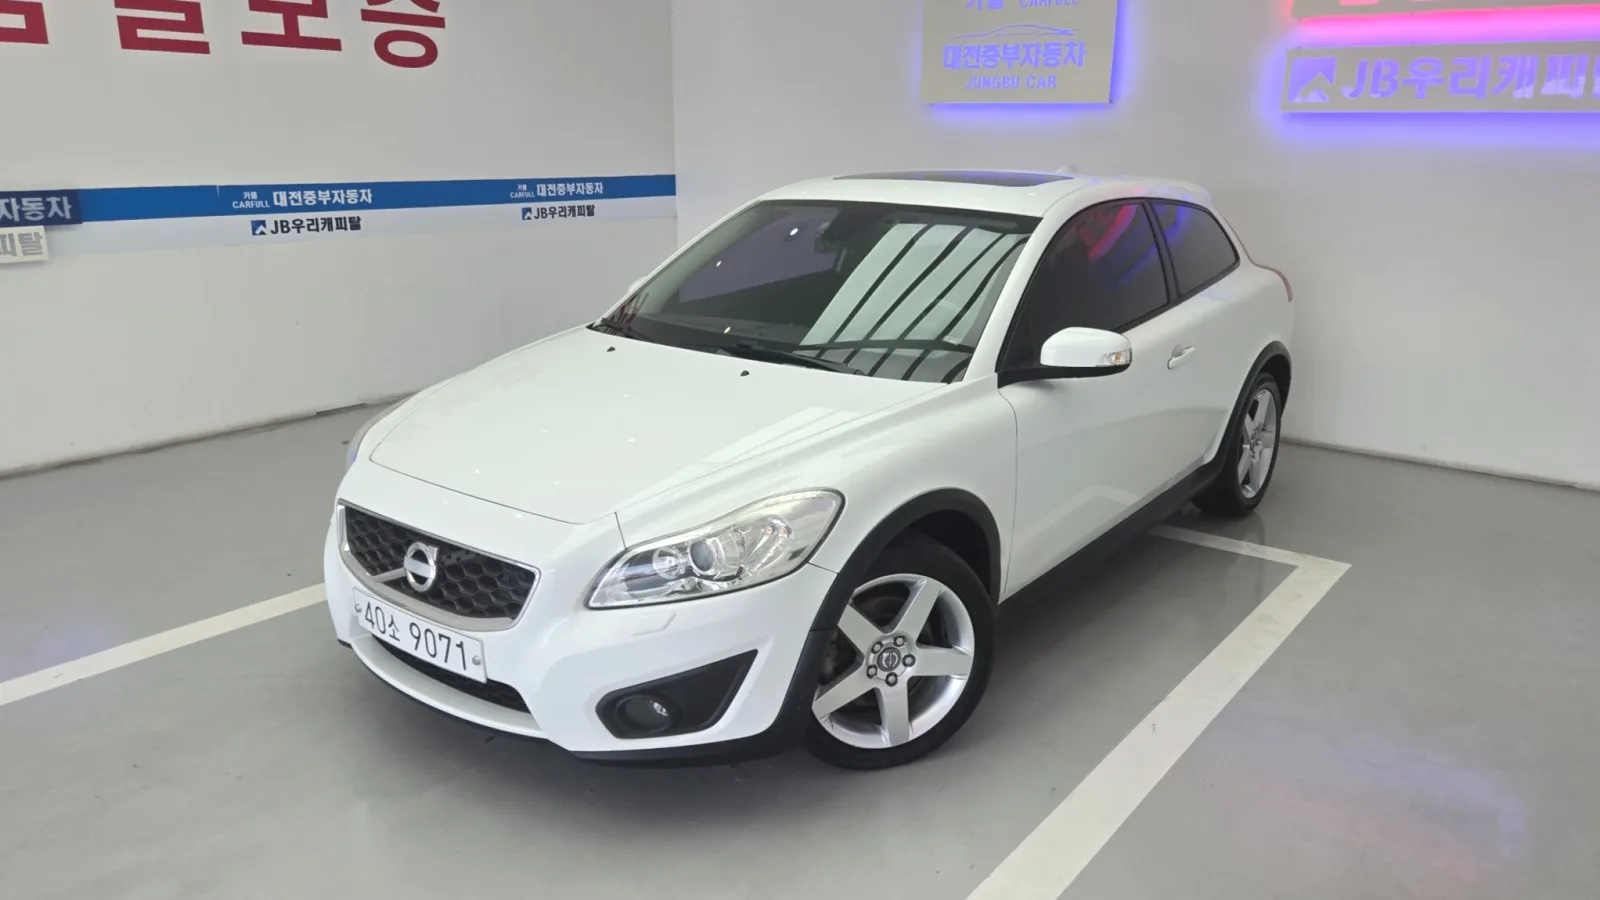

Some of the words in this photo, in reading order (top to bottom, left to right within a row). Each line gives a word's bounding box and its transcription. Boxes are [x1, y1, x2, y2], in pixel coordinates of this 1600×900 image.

[944, 41, 1086, 70] 대전중부자동차
[966, 76, 1020, 90] JUNGBU
[1026, 75, 1056, 89] CAR
[1340, 54, 1600, 99] JB우리캐피
[273, 189, 372, 207] 대전중부자동차
[537, 182, 603, 196] 대전중부자동차
[0, 196, 72, 222] 자동차
[232, 200, 270, 209] CARFULL
[534, 205, 595, 219] JB우리캐피탈
[270, 216, 361, 234] JB우리캐피탈
[364, 601, 400, 642] 40소
[409, 622, 467, 671] 9071
